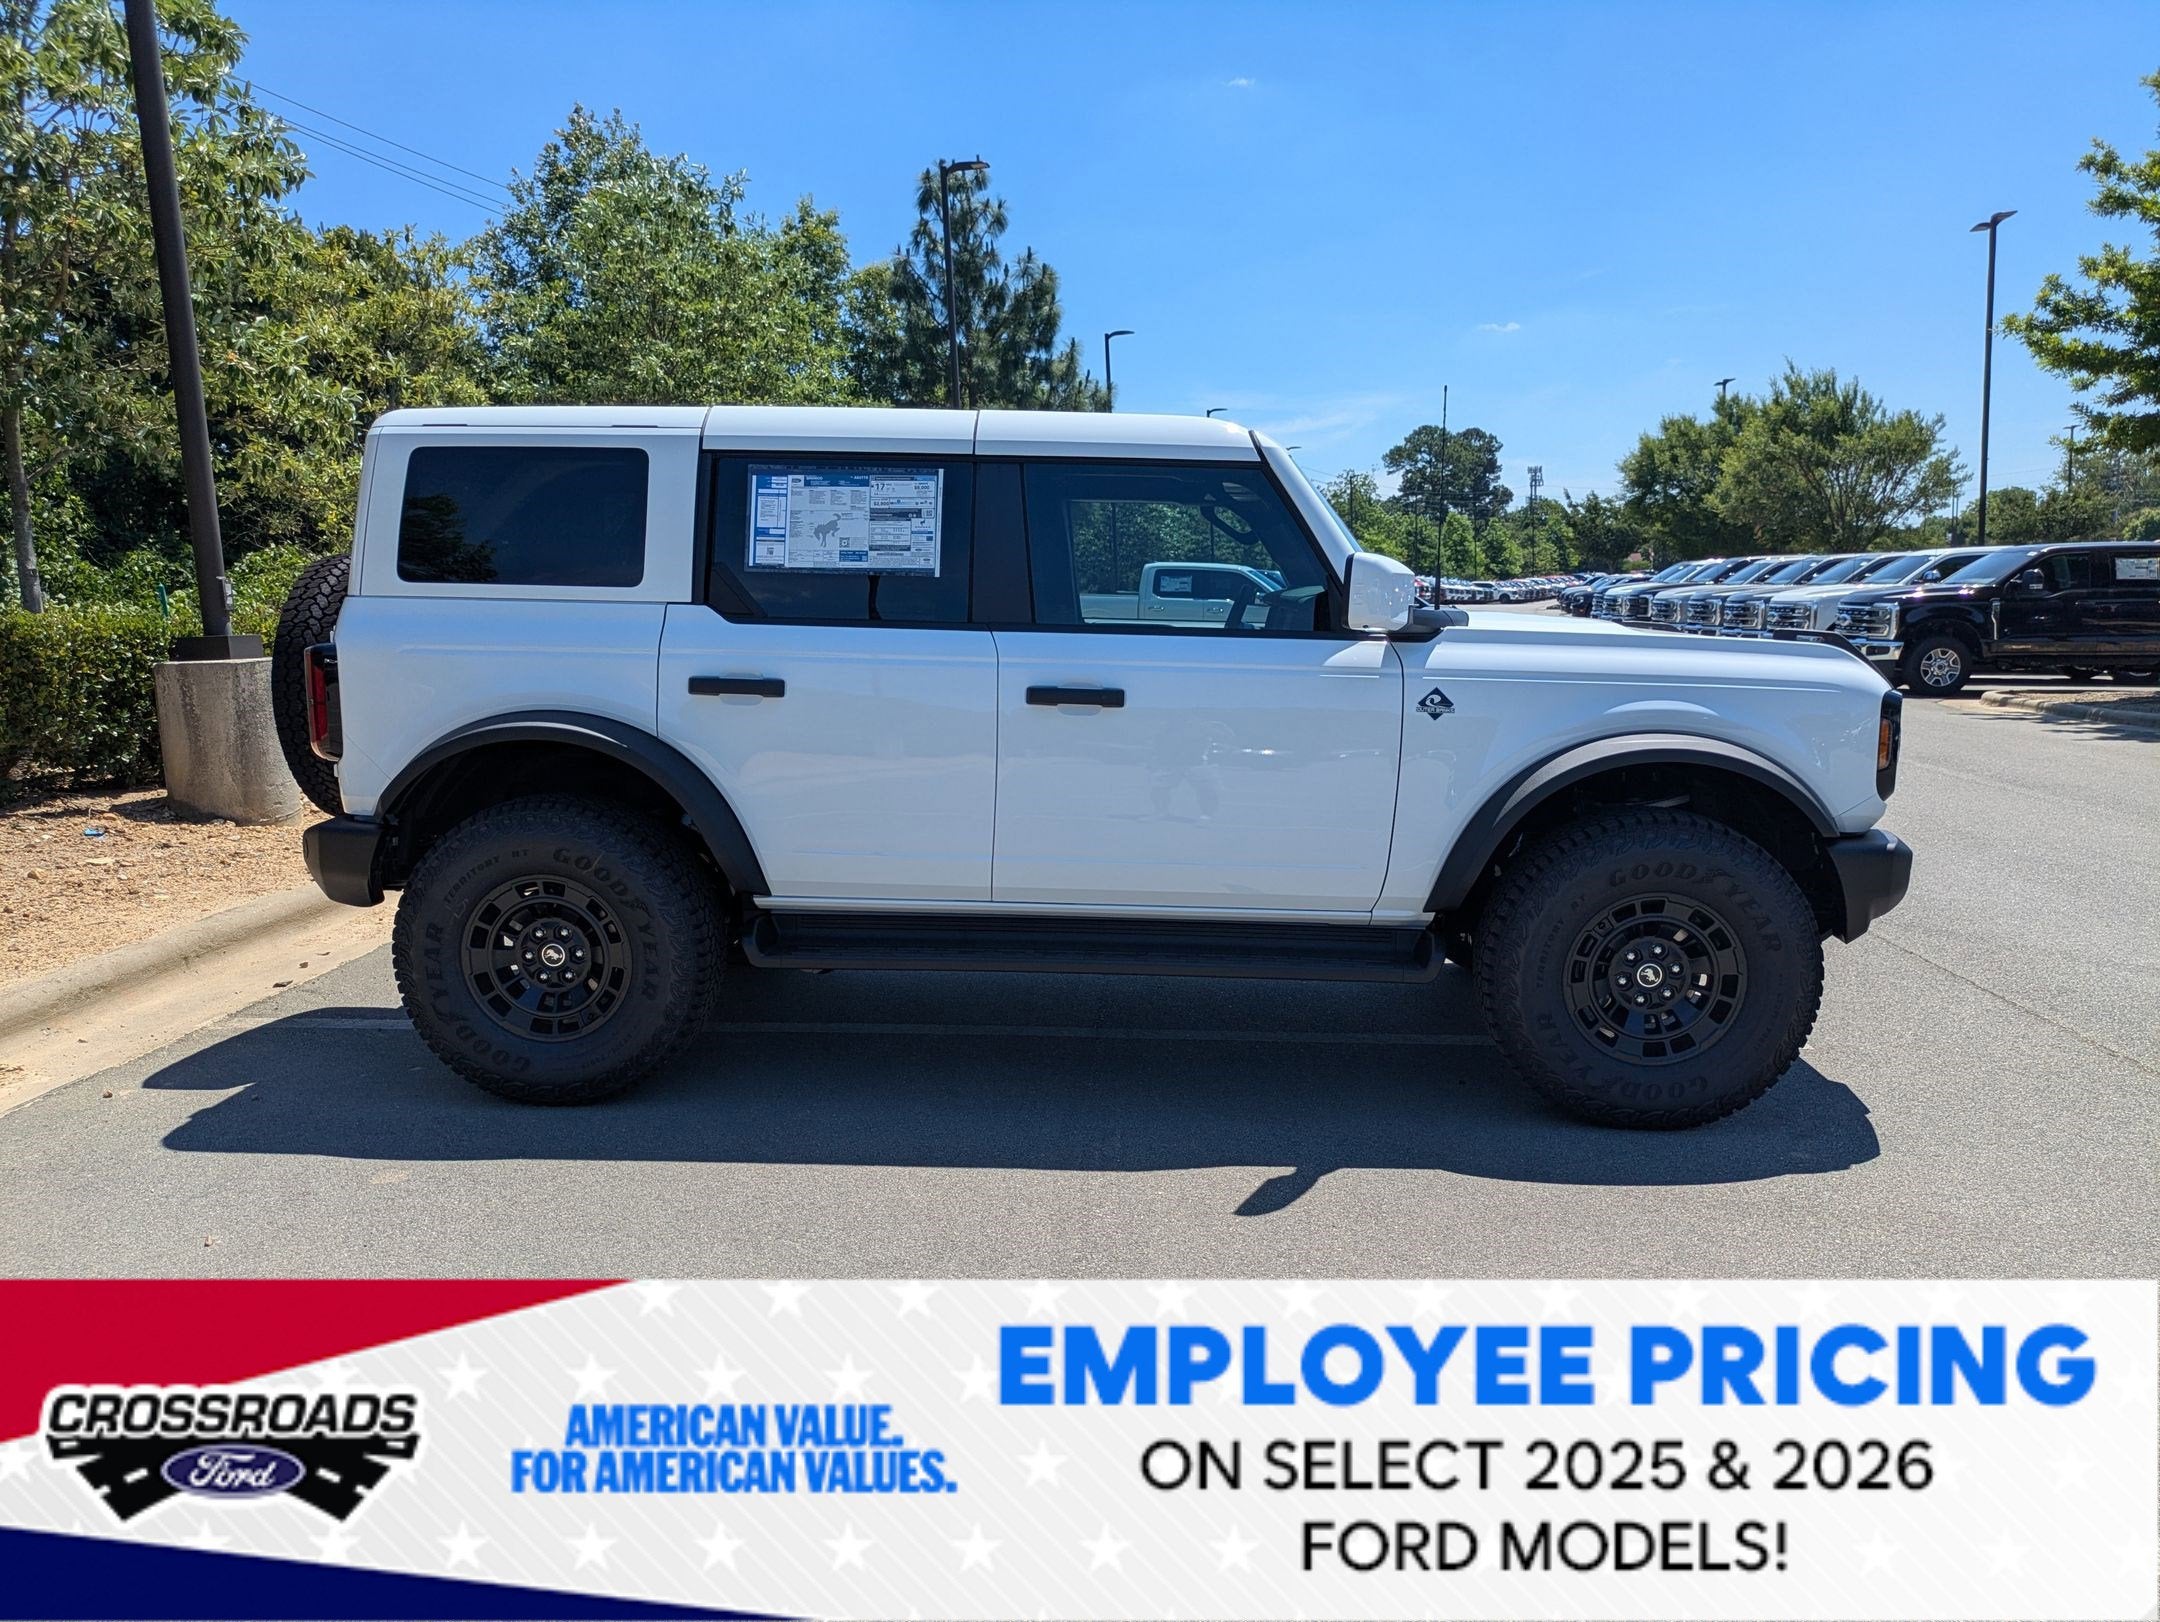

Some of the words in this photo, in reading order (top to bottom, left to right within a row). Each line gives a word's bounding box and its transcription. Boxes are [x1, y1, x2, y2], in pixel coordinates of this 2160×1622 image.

[443, 855, 500, 904] TERRITORY
[552, 846, 660, 1001] GOODYEAR
[1609, 860, 1785, 952] GOODYEAR
